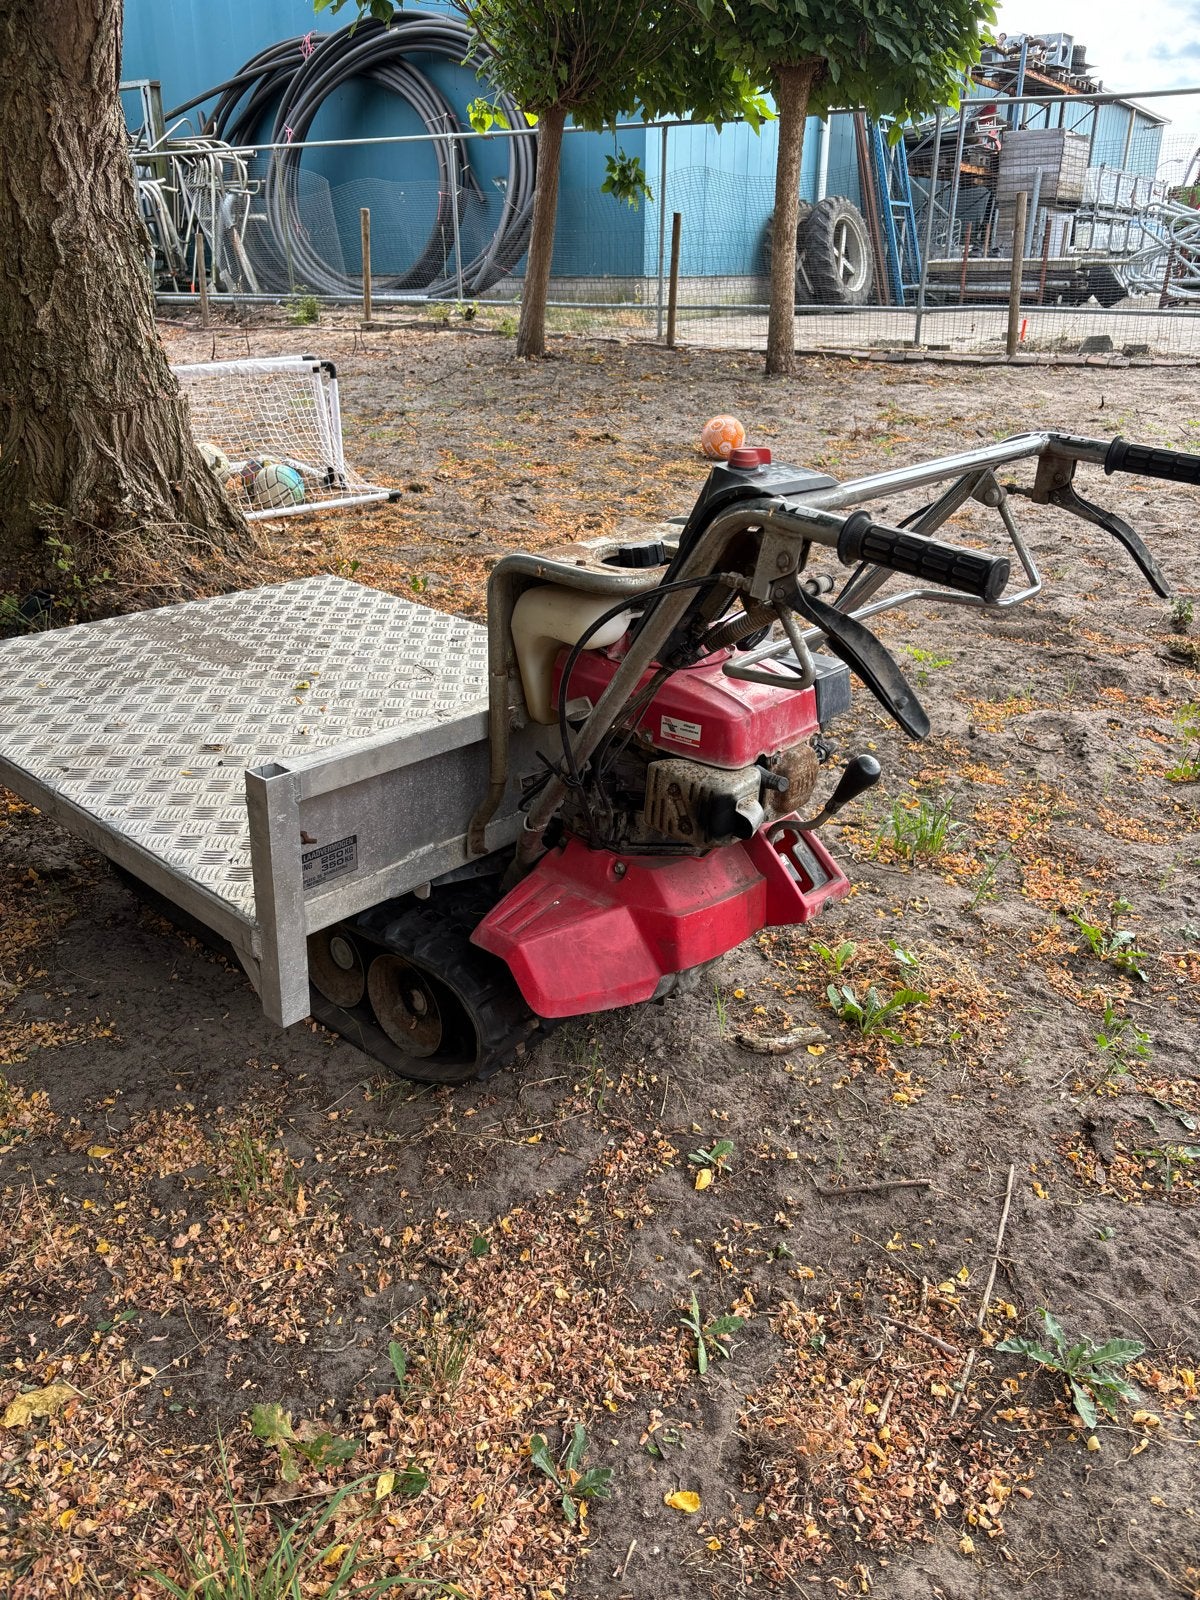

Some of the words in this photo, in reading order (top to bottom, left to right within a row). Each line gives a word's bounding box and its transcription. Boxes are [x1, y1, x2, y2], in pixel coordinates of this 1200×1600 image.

[321, 850, 344, 864] 250
[345, 846, 354, 855] KG
[321, 858, 344, 872] 350
[345, 854, 354, 863] KG
